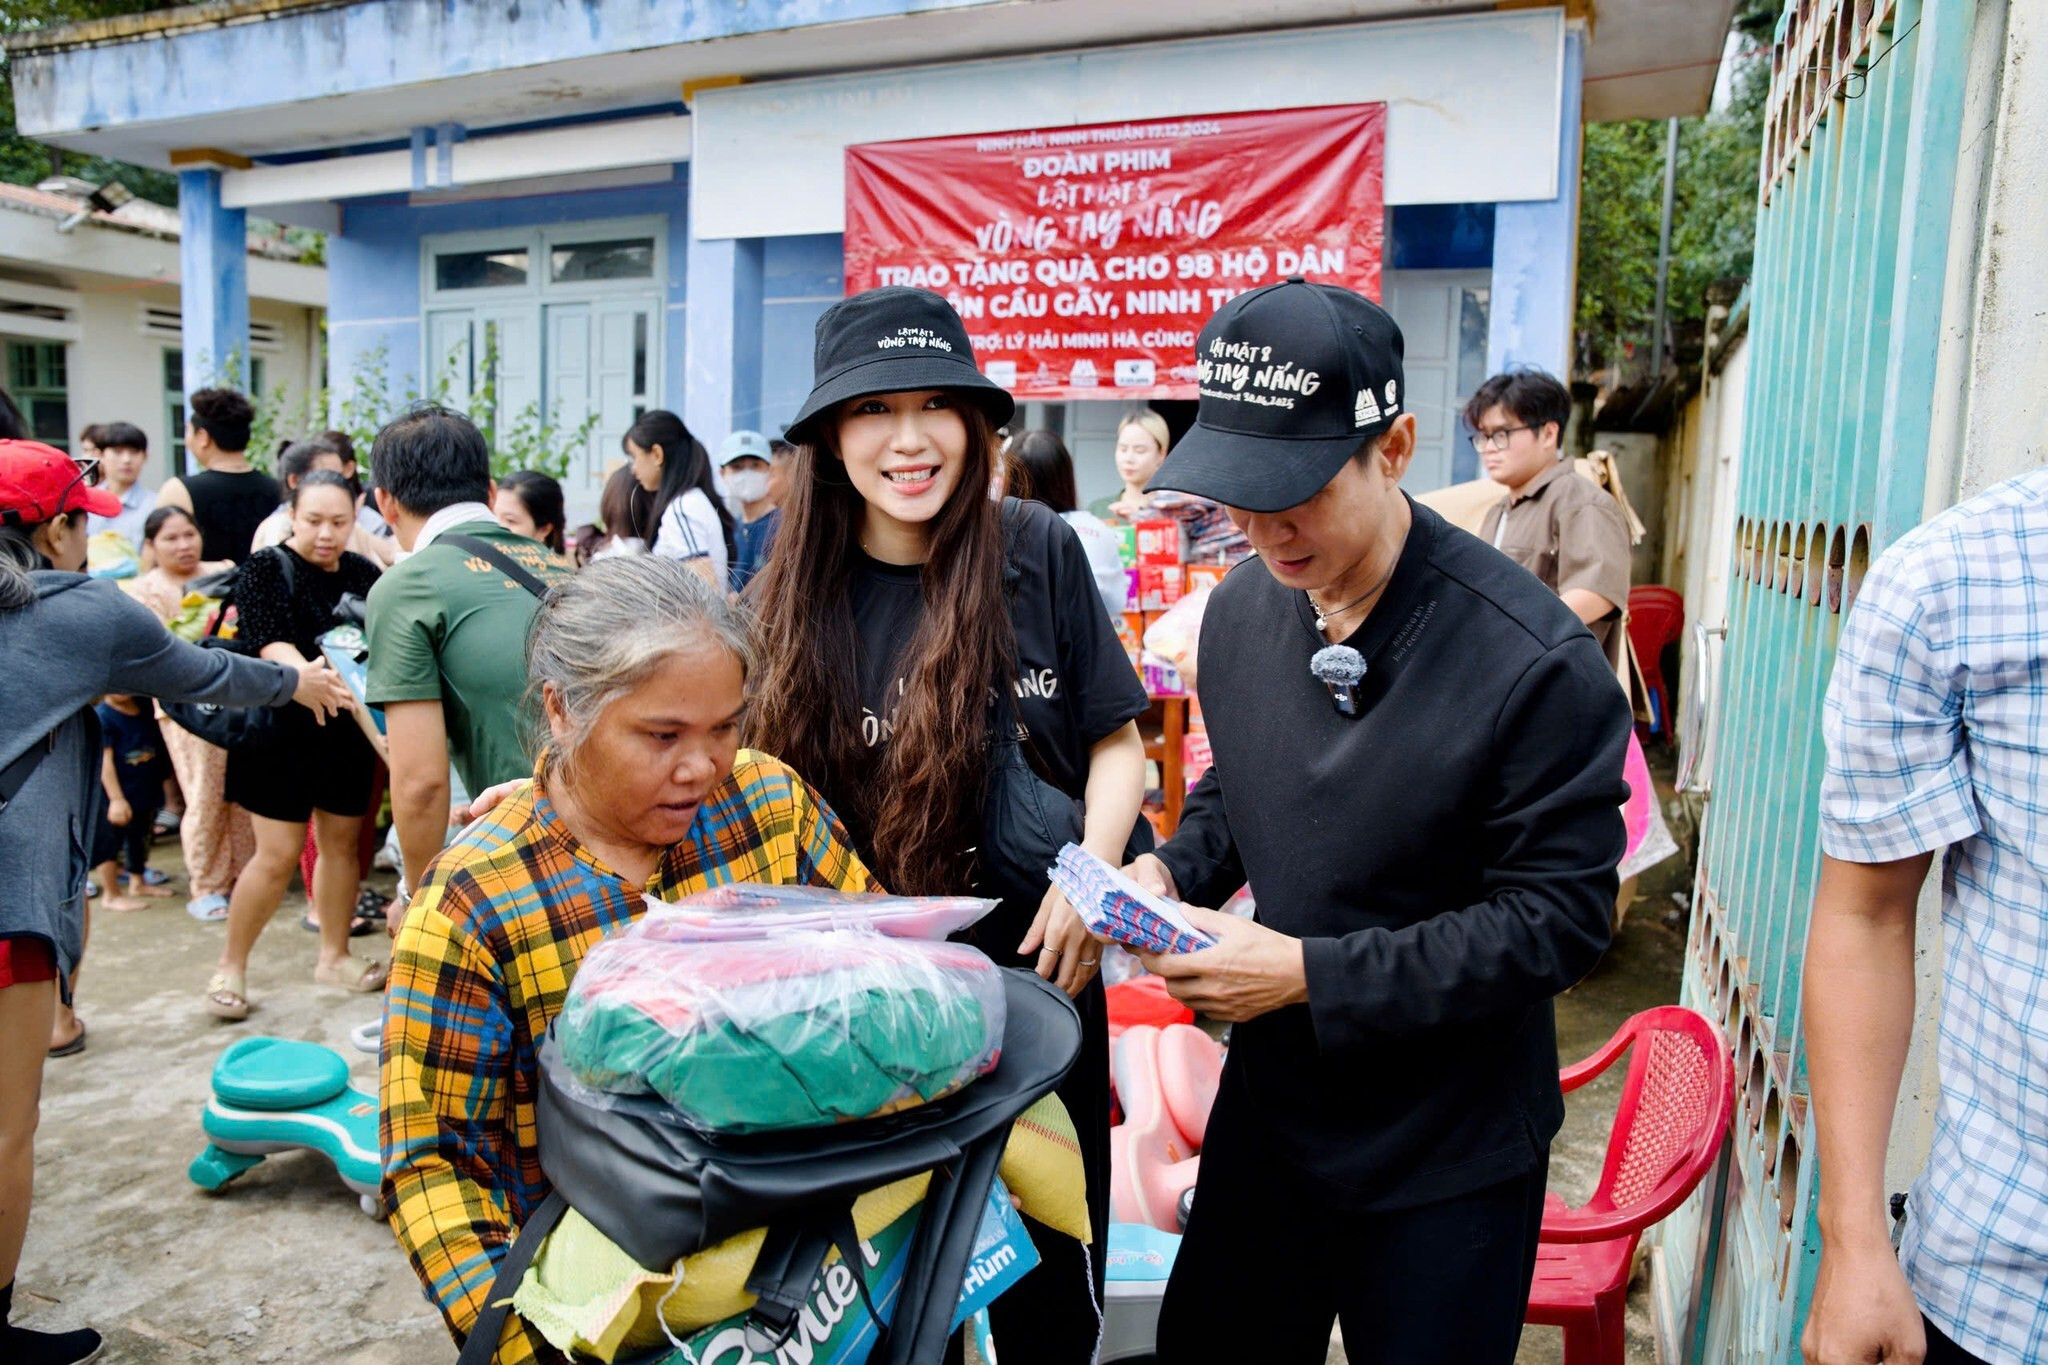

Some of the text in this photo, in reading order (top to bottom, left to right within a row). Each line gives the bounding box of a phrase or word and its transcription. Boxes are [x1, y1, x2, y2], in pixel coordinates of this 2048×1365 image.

[976, 139, 1014, 152] NINH
[1050, 132, 1089, 146] NINH
[1091, 124, 1144, 143] THUẬN
[1148, 122, 1221, 139] 17.12.2024
[1023, 149, 1171, 178] ĐOÀN PHIM
[1037, 179, 1080, 210] LẬT
[1083, 177, 1133, 207] MẶT
[975, 211, 1058, 254] VÒNG
[1133, 193, 1223, 240] NẮNG
[876, 244, 1345, 291] TRAO TẶNG QUÀ CHO 98 HỘ DÂN
[1053, 286, 1119, 320] GÃY,
[1126, 289, 1201, 315] NINH
[877, 336, 906, 348] VÒNG
[928, 337, 952, 352] NẮNG
[1005, 331, 1026, 350] LÝ
[1028, 328, 1059, 349] HẢI
[1062, 333, 1109, 349] MINH
[1111, 329, 1139, 348] HÀ
[1141, 329, 1194, 348] CÙNG
[1225, 341, 1260, 363] MẶT
[1261, 346, 1272, 362] 8
[1214, 363, 1250, 391] TAY
[1253, 361, 1320, 396] NẮNG
[1392, 617, 1418, 647] MAKING
[1406, 600, 1438, 647] DOWNTOWN
[964, 1244, 1017, 1295] Hùm
